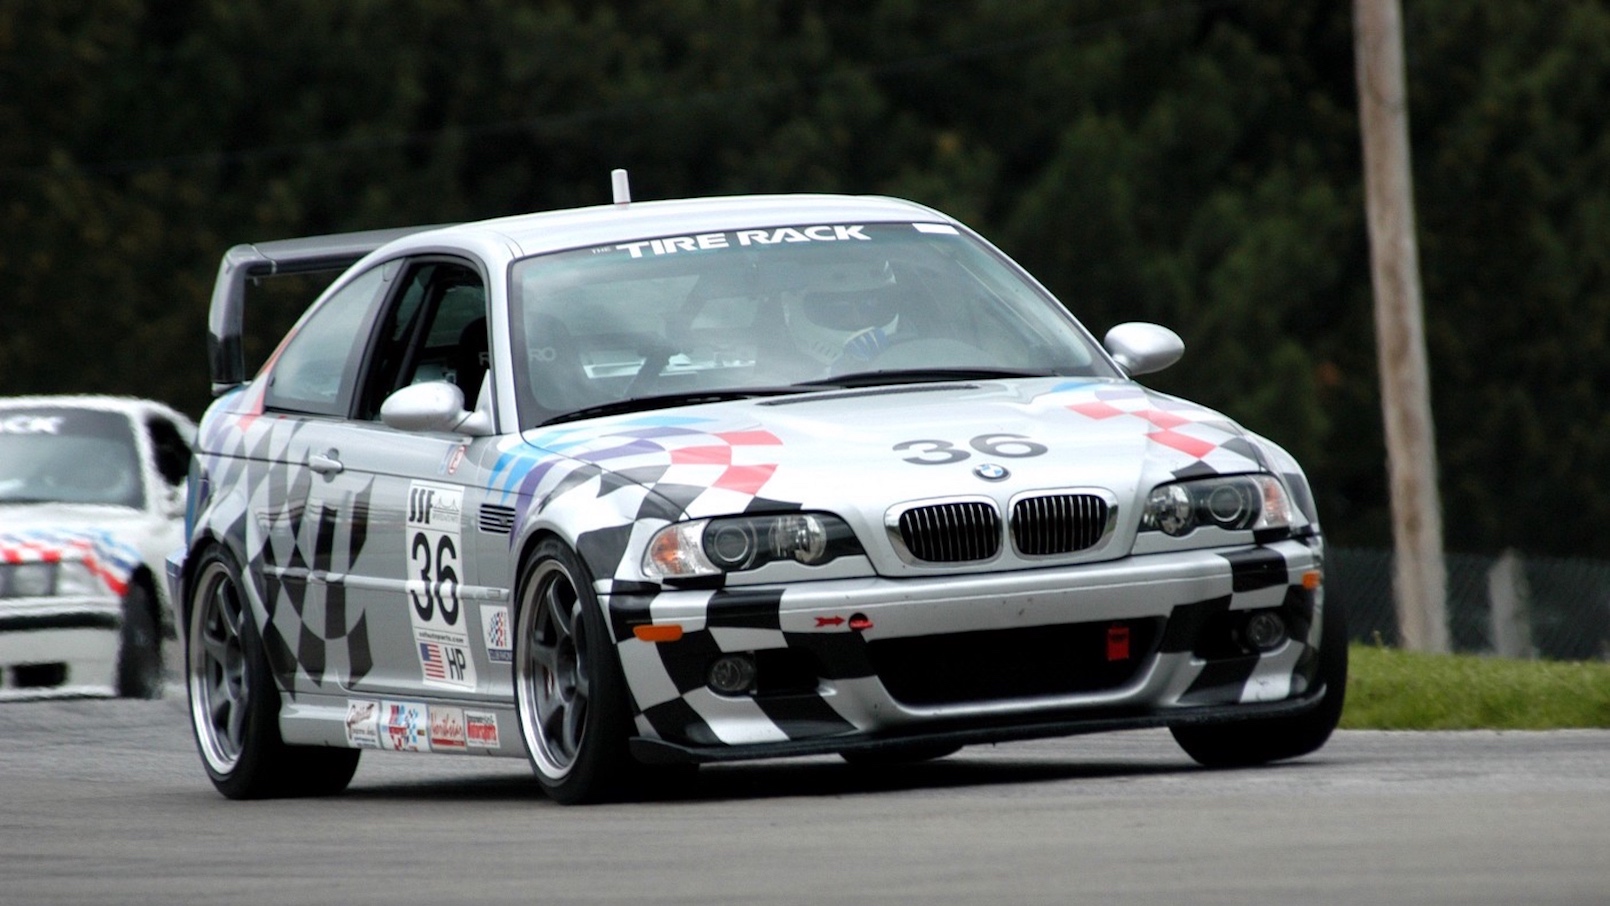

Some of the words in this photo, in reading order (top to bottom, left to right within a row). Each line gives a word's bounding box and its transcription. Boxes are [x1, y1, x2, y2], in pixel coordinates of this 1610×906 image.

[592, 247, 612, 255] THE
[616, 232, 729, 258] TIRE
[736, 225, 872, 246] RACK
[892, 433, 1048, 465] 36
[409, 488, 435, 525] SSF
[412, 532, 459, 626] 36
[445, 647, 466, 681] HP
